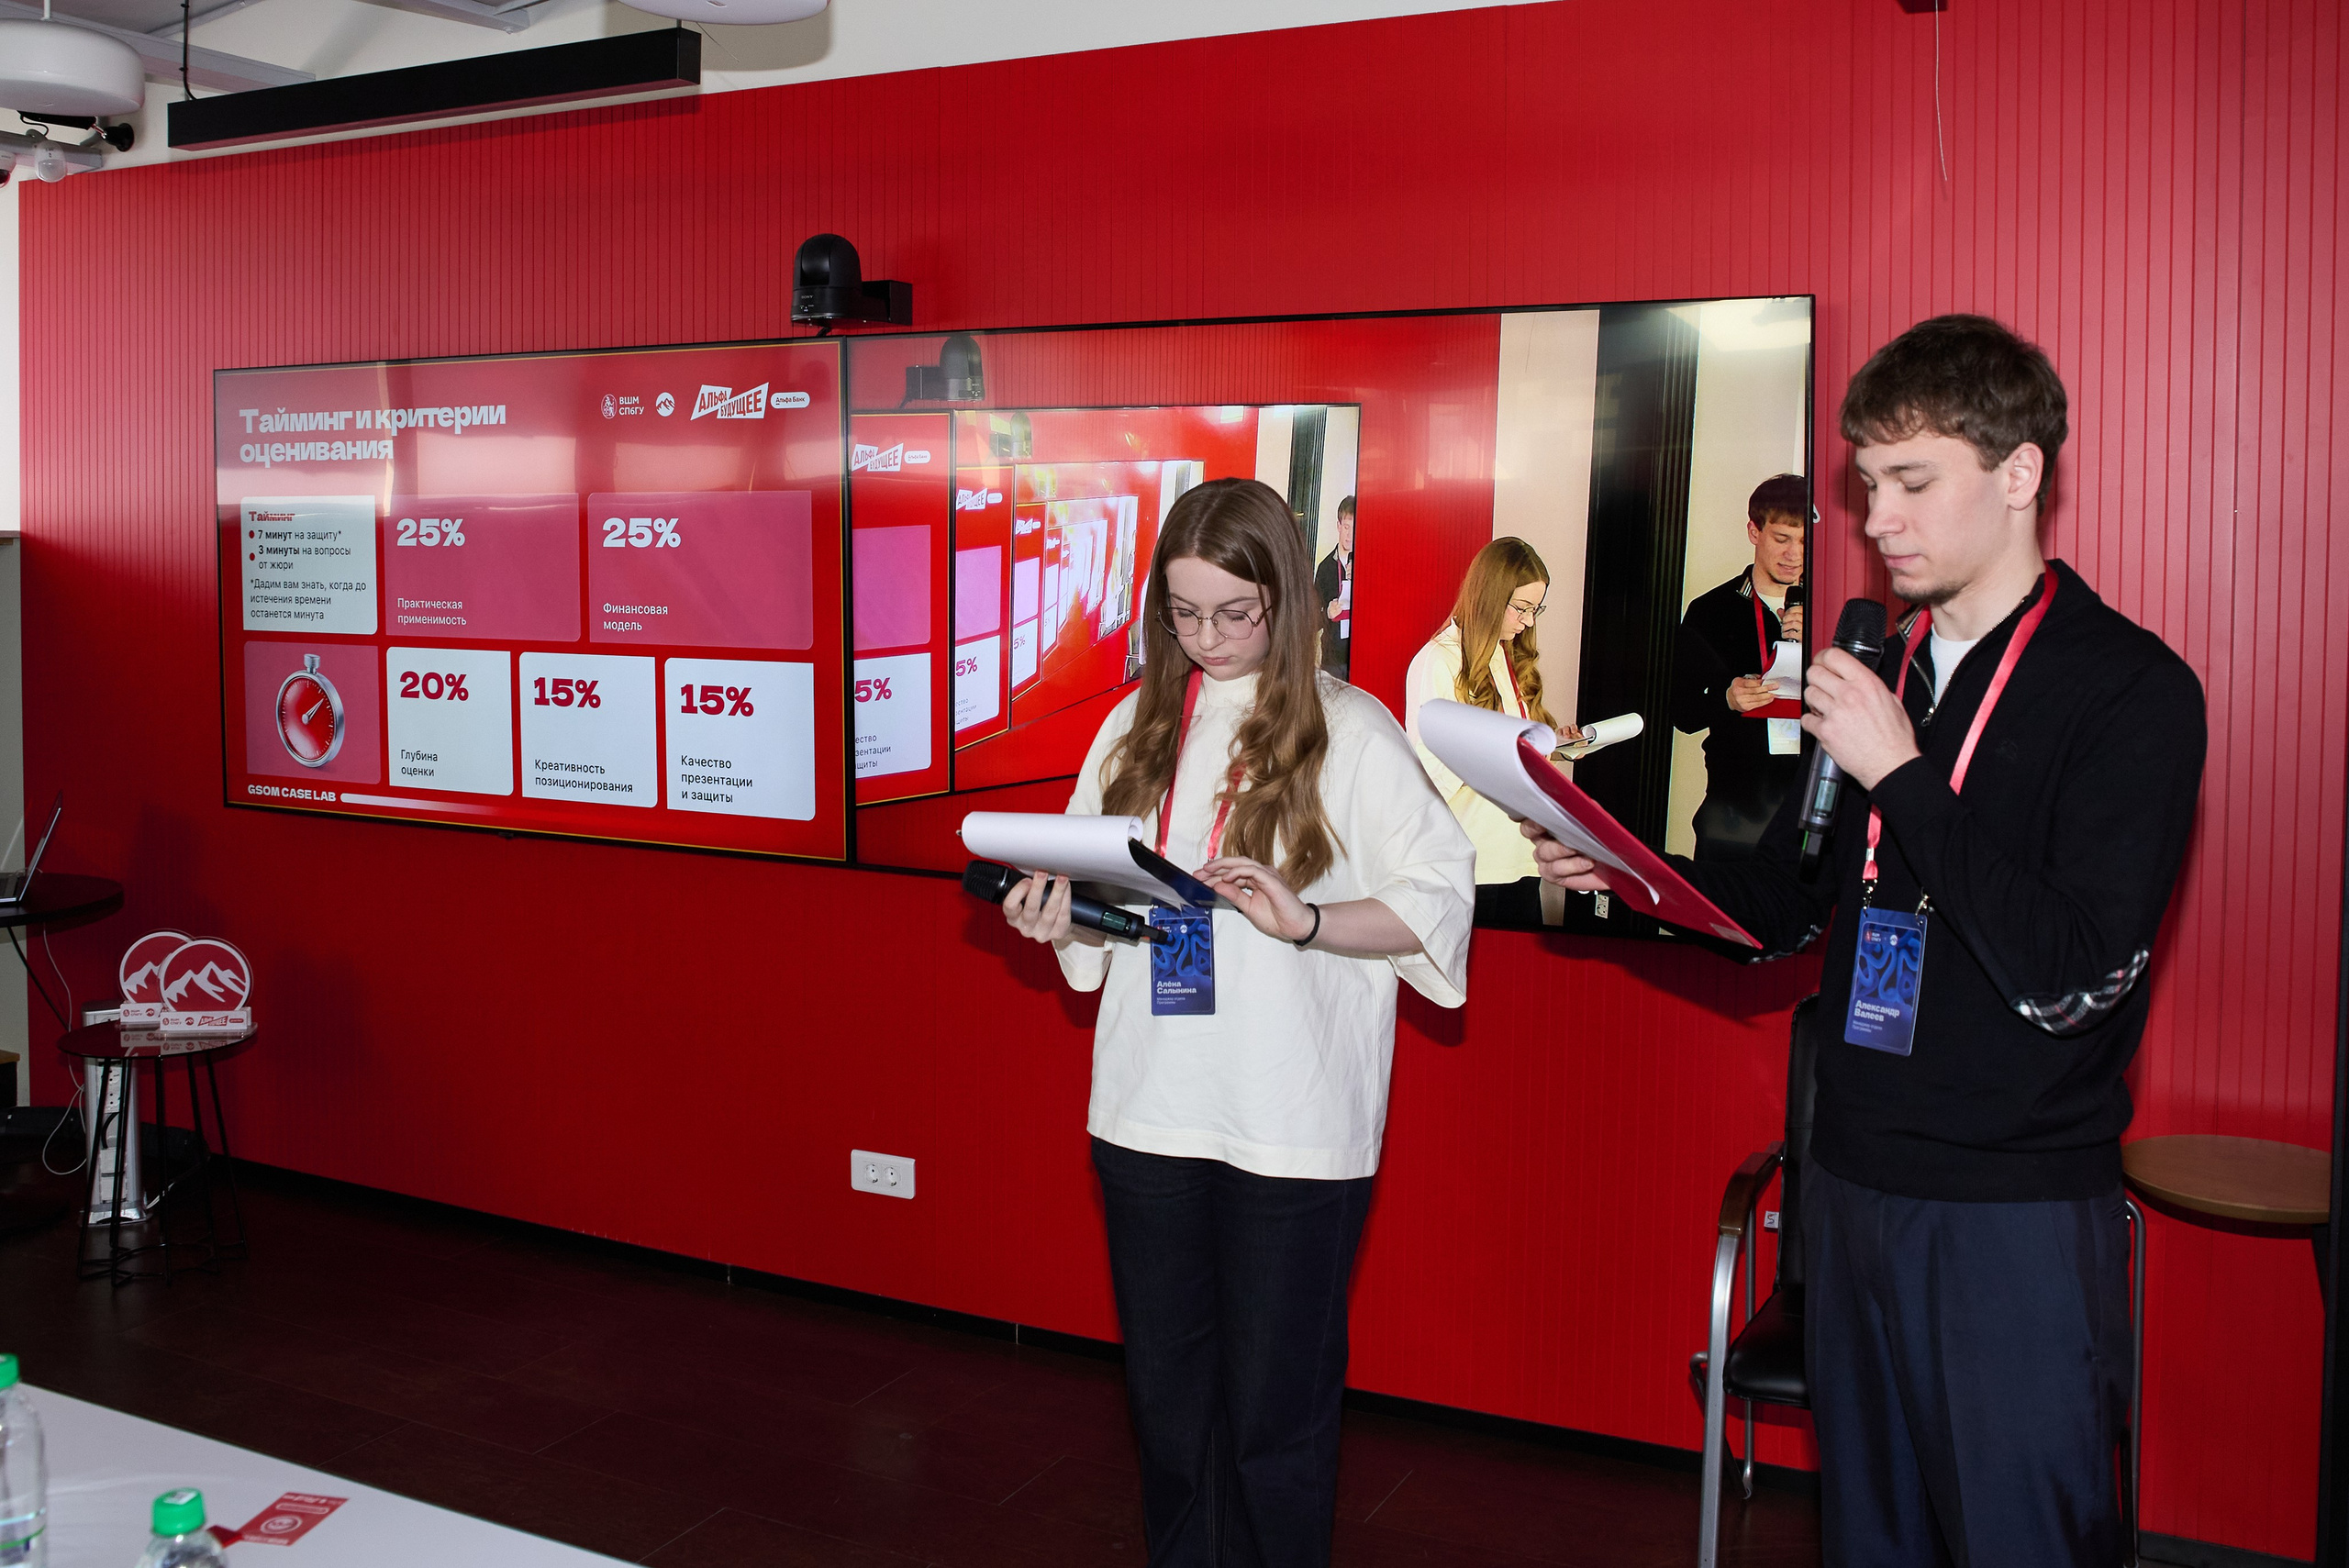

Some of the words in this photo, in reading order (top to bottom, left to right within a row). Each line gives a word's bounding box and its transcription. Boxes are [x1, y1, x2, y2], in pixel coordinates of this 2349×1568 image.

[619, 396, 640, 405] ВШМ
[698, 390, 728, 413] АЛЬФА
[720, 389, 763, 417] БУДУЩЕЕ
[775, 396, 792, 406] Альфа
[792, 395, 806, 404] Банк
[618, 406, 644, 416] СПбГУ
[239, 406, 353, 433] Тайминг
[355, 410, 372, 429] и
[375, 405, 506, 437] критерии
[239, 439, 394, 469] оценивания
[249, 511, 295, 521] Тайминг
[258, 529, 263, 539] 7
[265, 530, 293, 541] минут
[295, 531, 305, 539] на
[396, 517, 466, 547] 25%
[602, 517, 682, 548] 25%
[258, 544, 264, 554] 3
[266, 545, 300, 557] минуты
[302, 547, 312, 555] на
[315, 546, 351, 557] вопросы
[259, 561, 268, 570] от
[270, 561, 294, 571] жюри
[283, 580, 299, 589] вам
[301, 580, 327, 591] знать,
[329, 581, 353, 592] когда
[355, 582, 367, 592] до
[250, 595, 293, 604] истечения
[295, 595, 331, 606] времени
[397, 597, 463, 612] Практическая
[250, 609, 292, 618] останется
[294, 610, 324, 621] минута
[603, 602, 669, 616] Финансовая
[397, 614, 467, 626] применимость
[603, 619, 643, 632] модель
[399, 671, 469, 702] 20%
[533, 677, 601, 708] 15%
[854, 677, 893, 703] 5%
[680, 684, 754, 717] 15%
[400, 749, 439, 762] Глубина
[681, 754, 732, 769] Качество
[401, 765, 435, 777] оценки
[534, 759, 606, 774] Креативность
[854, 760, 878, 770] щиты
[535, 776, 633, 793] позиционирования
[681, 773, 753, 788] презентации
[248, 784, 280, 797] GSOM
[281, 787, 312, 800] CASE
[313, 790, 337, 802] LAB
[681, 790, 688, 799] и
[691, 790, 733, 803] защиты
[1854, 1007, 1885, 1022] Валеев
[1855, 999, 1900, 1018] Александр
